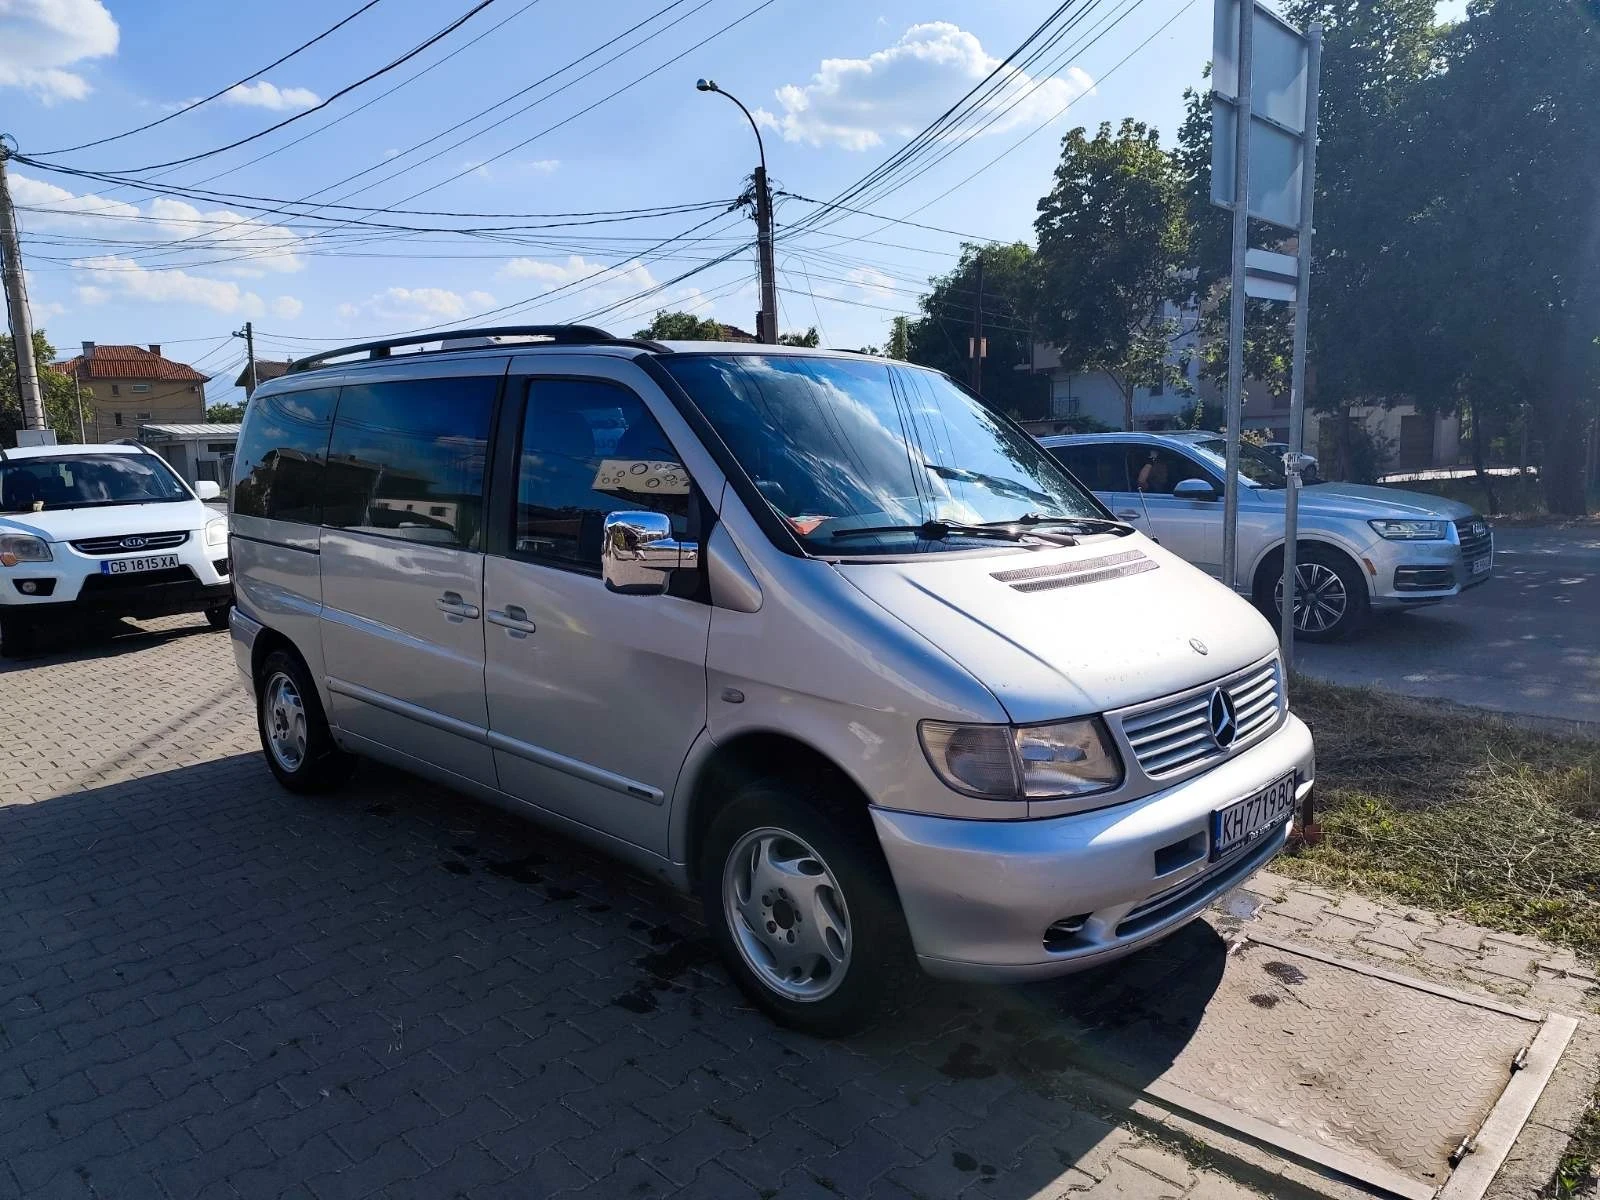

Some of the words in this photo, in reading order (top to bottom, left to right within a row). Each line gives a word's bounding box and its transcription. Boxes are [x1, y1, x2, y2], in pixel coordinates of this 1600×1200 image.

[125, 539, 143, 547] KIA
[110, 561, 128, 573] CB
[132, 558, 159, 571] 1815
[161, 556, 176, 568] XA
